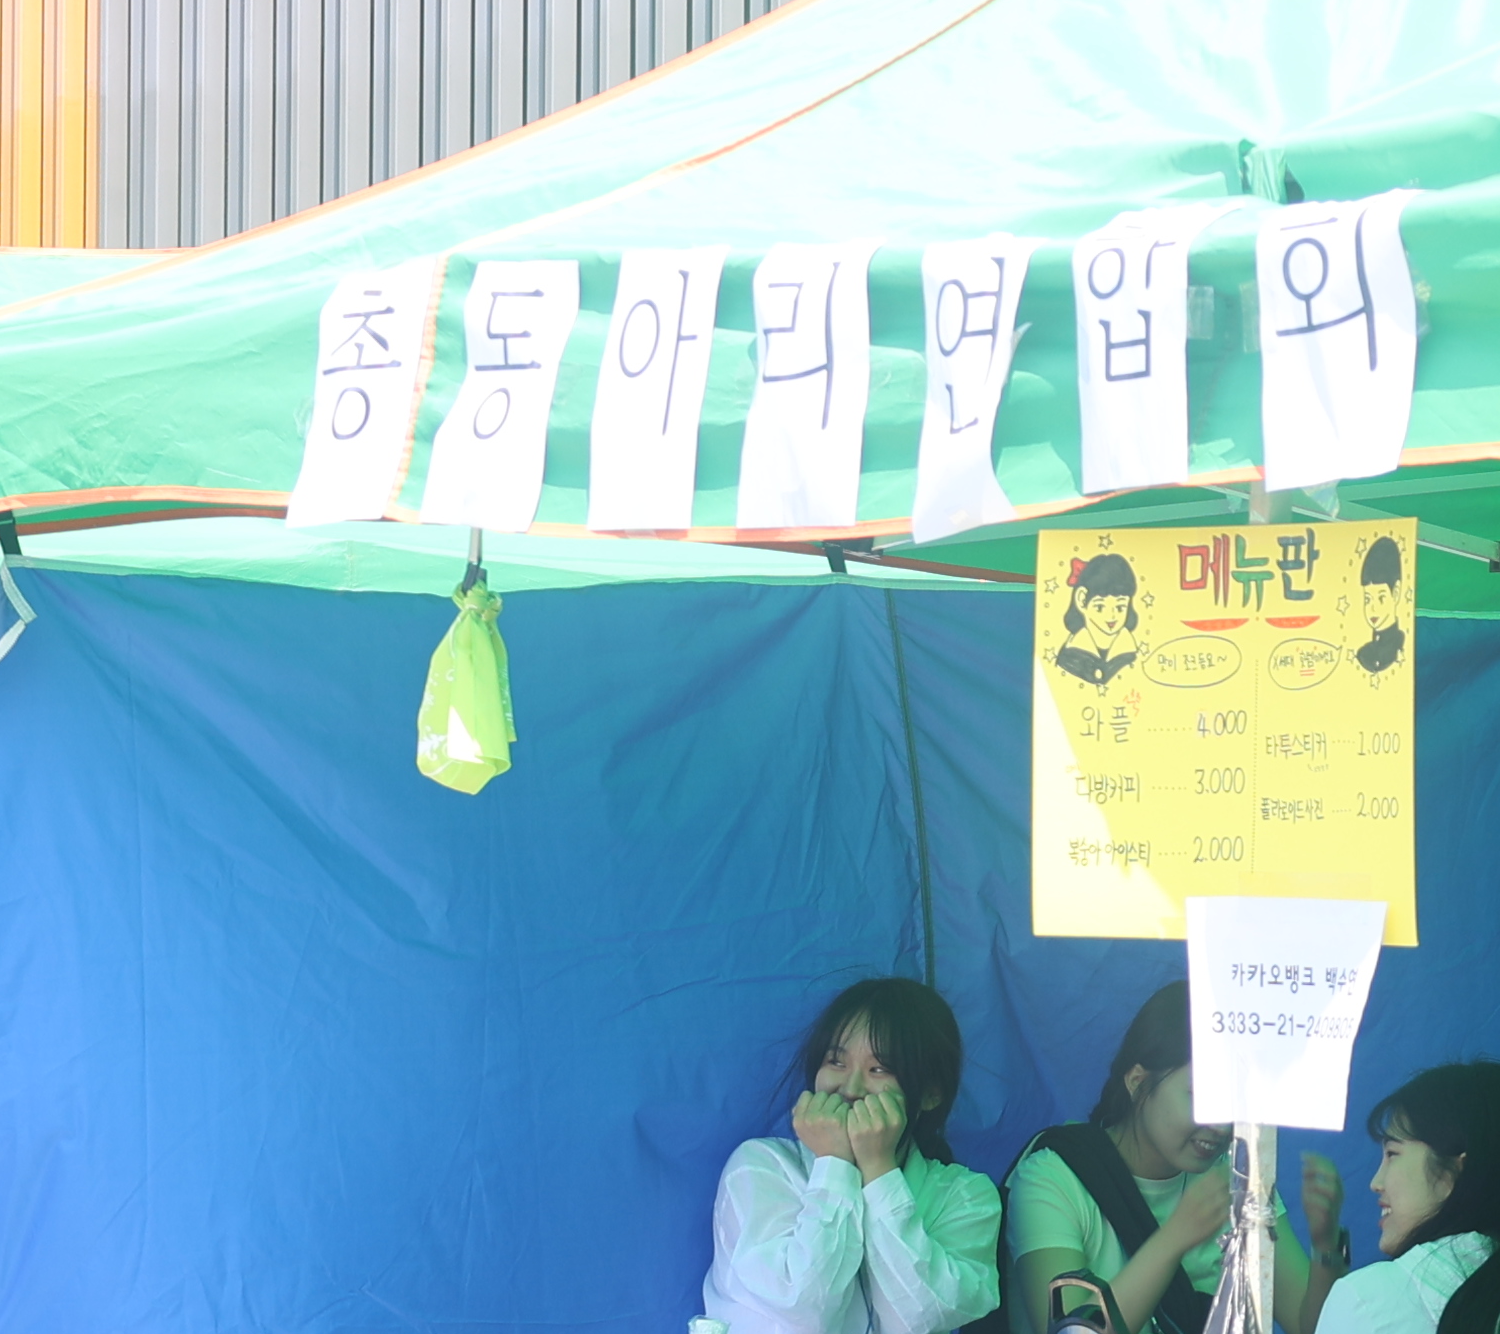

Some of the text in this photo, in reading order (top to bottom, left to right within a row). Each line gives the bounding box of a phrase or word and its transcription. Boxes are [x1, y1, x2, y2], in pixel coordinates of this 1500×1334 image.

[1177, 528, 1319, 612] 메뉴판
[1196, 709, 1248, 738] 4.000
[1265, 730, 1401, 760] 타투스티커 1.000
[1074, 767, 1246, 804] 다방커피 3.000
[1356, 792, 1400, 819] 2.000
[1068, 835, 1245, 868] 복숭아 아이스티 2.000
[1231, 962, 1316, 994] 카카오뱅크
